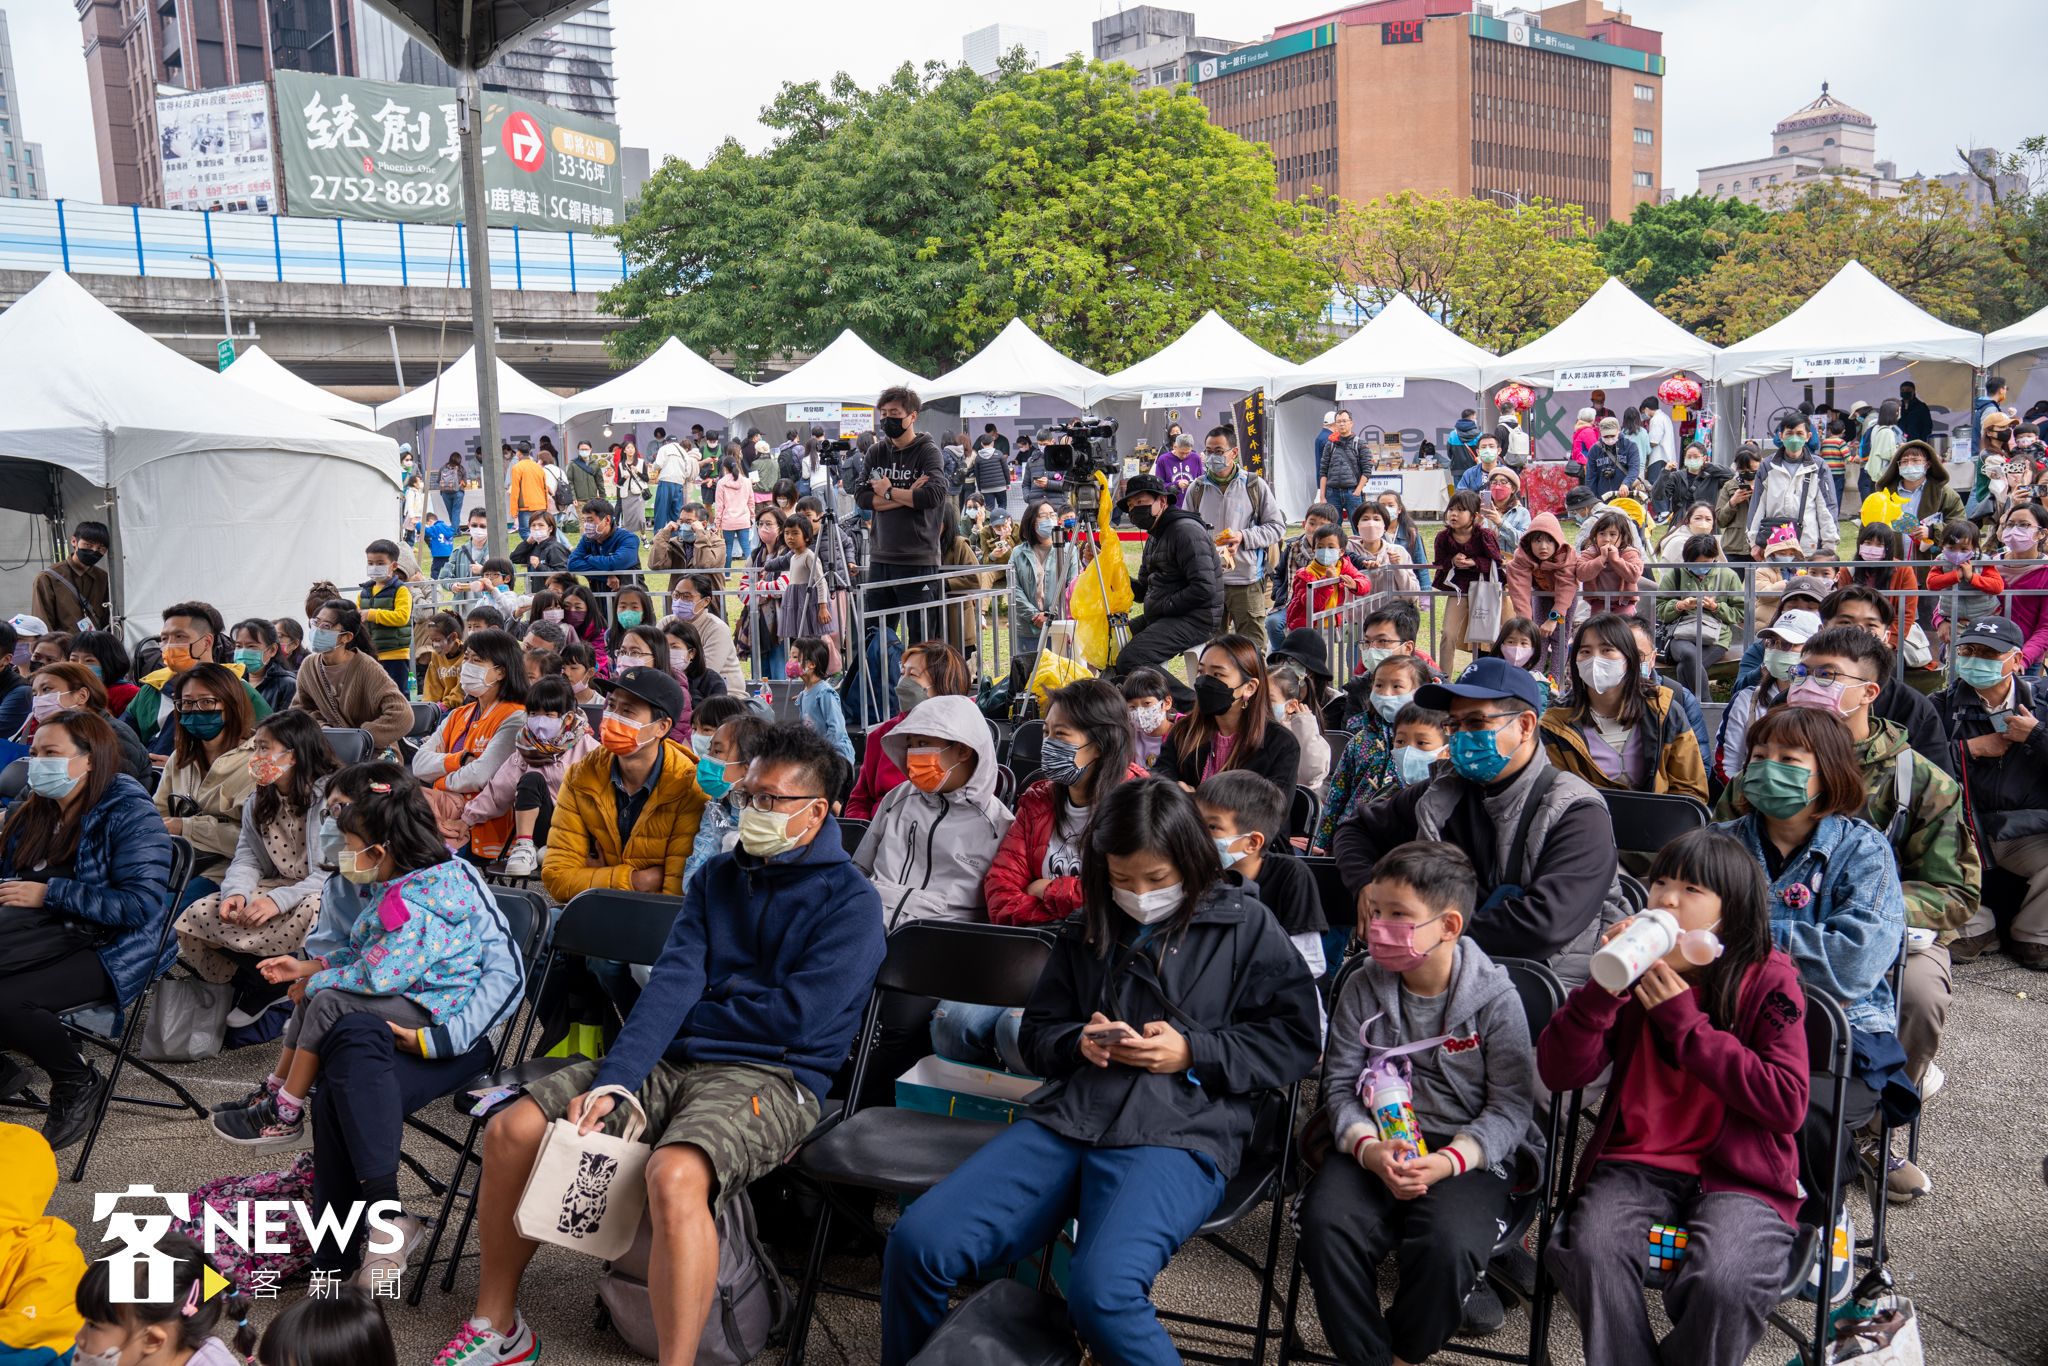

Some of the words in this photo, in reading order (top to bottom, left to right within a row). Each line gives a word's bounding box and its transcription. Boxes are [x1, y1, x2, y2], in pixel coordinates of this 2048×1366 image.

[1534, 33, 1557, 47] 第一銀行
[1566, 43, 1576, 51] Bank
[1220, 54, 1247, 70] 第一銀行
[1257, 51, 1269, 59] Bank
[563, 132, 606, 161] 即將公開
[377, 161, 415, 173] Phoenix
[417, 164, 437, 175] One
[558, 153, 606, 186] 33-56坪
[309, 174, 451, 207] 2752-8628
[485, 187, 541, 217] 鹿營造
[1382, 381, 1395, 389] Day
